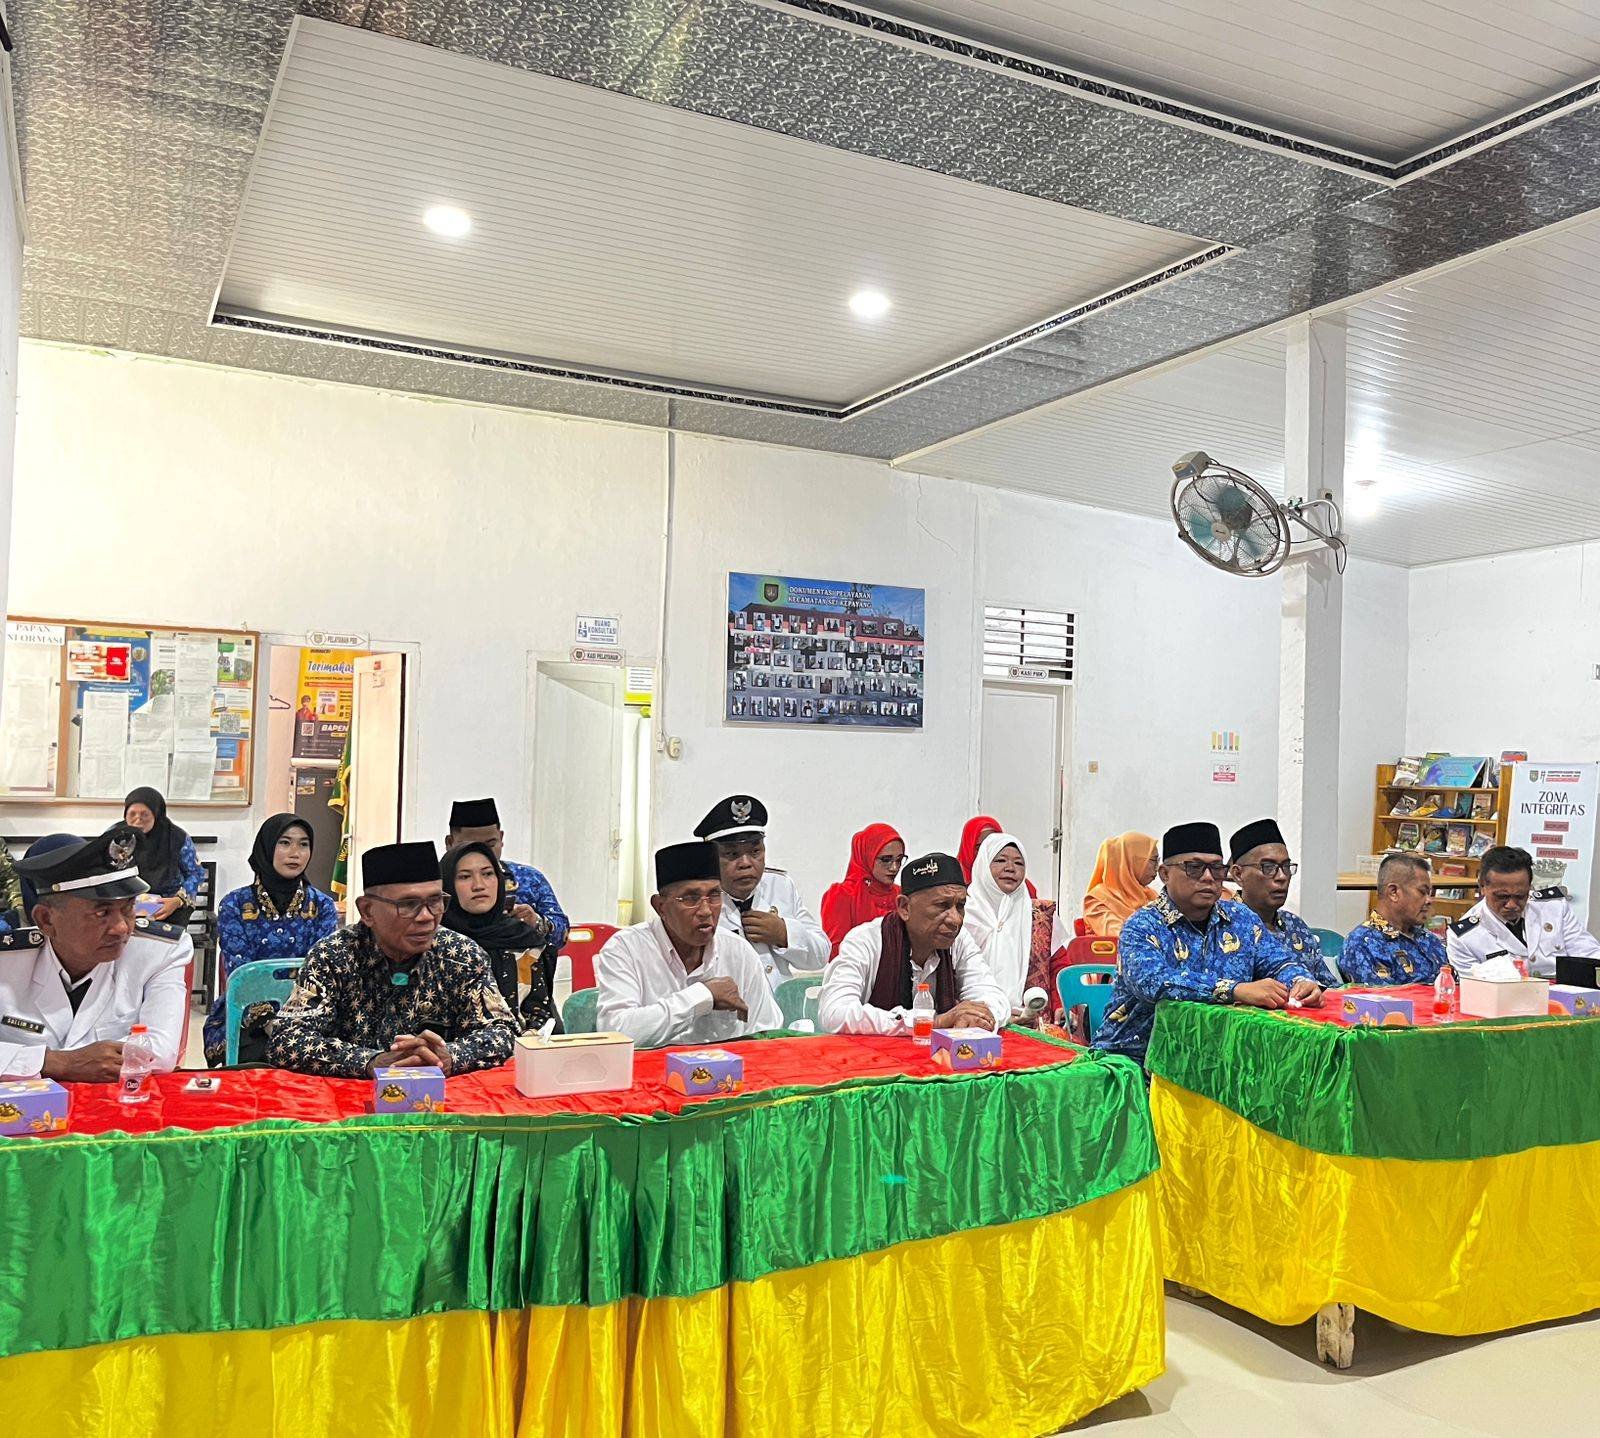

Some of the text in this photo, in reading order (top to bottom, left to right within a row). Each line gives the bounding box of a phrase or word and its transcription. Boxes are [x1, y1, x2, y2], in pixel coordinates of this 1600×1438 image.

[789, 586, 872, 599] DOKUMENTASI PELAYANAN
[788, 596, 826, 605] KECAMATAN
[15, 623, 51, 632] PAPAN
[1538, 790, 1569, 803] ZONA
[1520, 802, 1586, 816] INTEGRITAS
